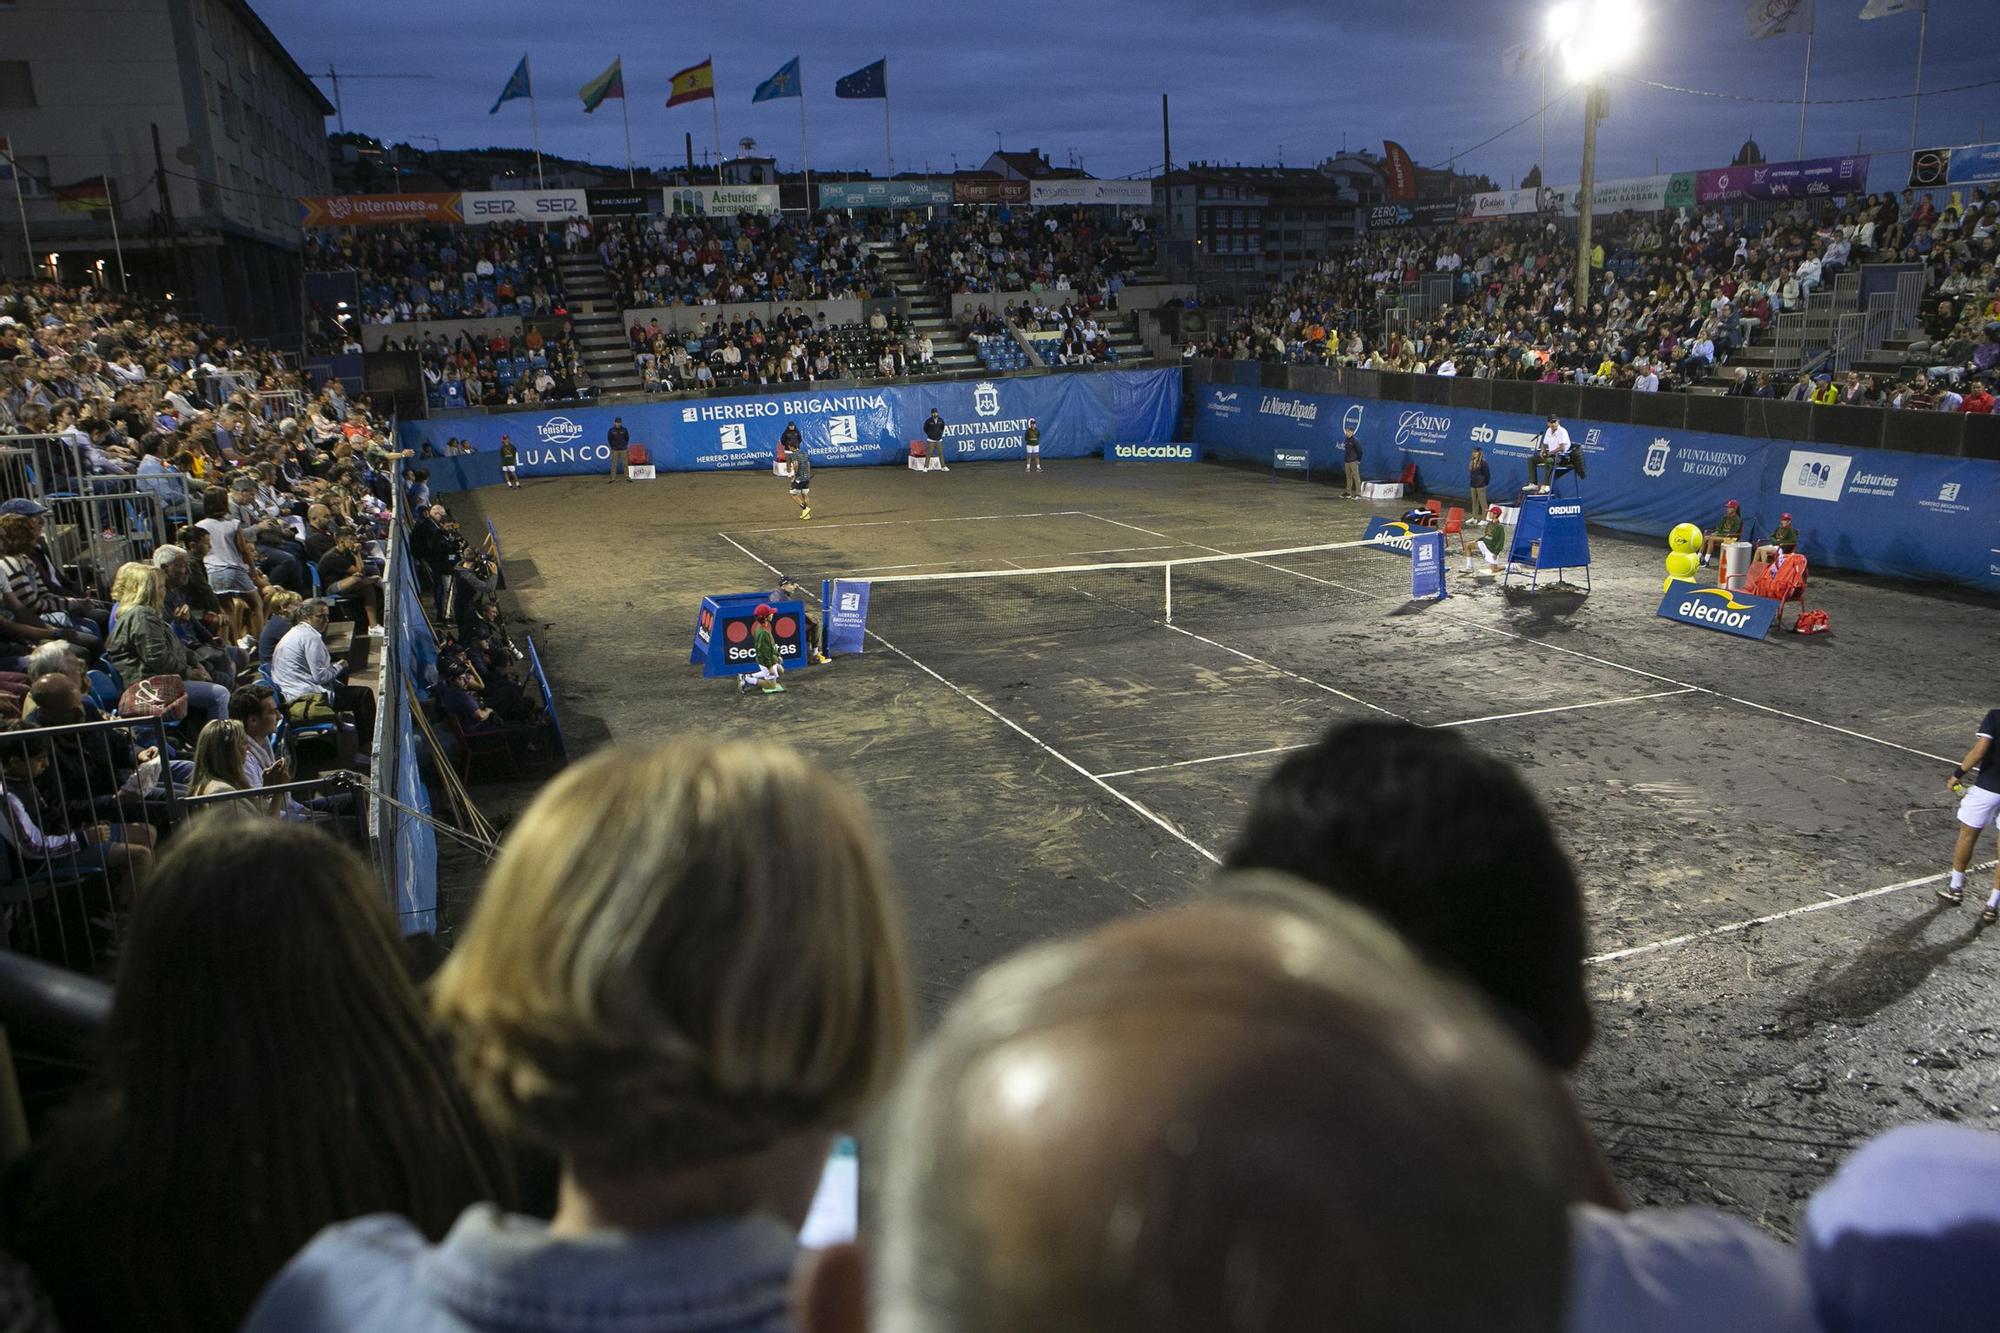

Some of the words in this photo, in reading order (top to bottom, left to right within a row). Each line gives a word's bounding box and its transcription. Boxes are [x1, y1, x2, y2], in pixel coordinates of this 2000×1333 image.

[1672, 179, 1689, 194] 03
[712, 190, 758, 204] Asturias
[474, 200, 516, 214] SER
[536, 198, 577, 213] SER
[1371, 206, 1395, 218] ZERO
[701, 402, 779, 421] HERRERO
[783, 395, 887, 415] BRIGANTINA
[1259, 396, 1270, 414] La
[1268, 397, 1292, 416] Nueva
[1290, 399, 1318, 421] España
[536, 424, 583, 436] TenisPlaya
[942, 418, 1036, 437] AYUNTAMIENTO
[1470, 424, 1494, 442] sto
[807, 446, 839, 456] HERRERO
[841, 443, 881, 453] BRIGANTINA
[958, 440, 976, 452] DE
[1115, 444, 1193, 458] telecable
[515, 445, 611, 466] LUANCO
[696, 455, 728, 464] HERRERO
[730, 451, 774, 461] BRIGANTINA
[1676, 448, 1746, 466] AYUNTAMIENTO
[1682, 462, 1697, 474] DE
[1852, 470, 1899, 487] Asturias
[1549, 505, 1580, 515] ORDUM
[1375, 530, 1413, 552] elecno
[1679, 598, 1751, 629] elecnor
[729, 643, 797, 660] Sectas
